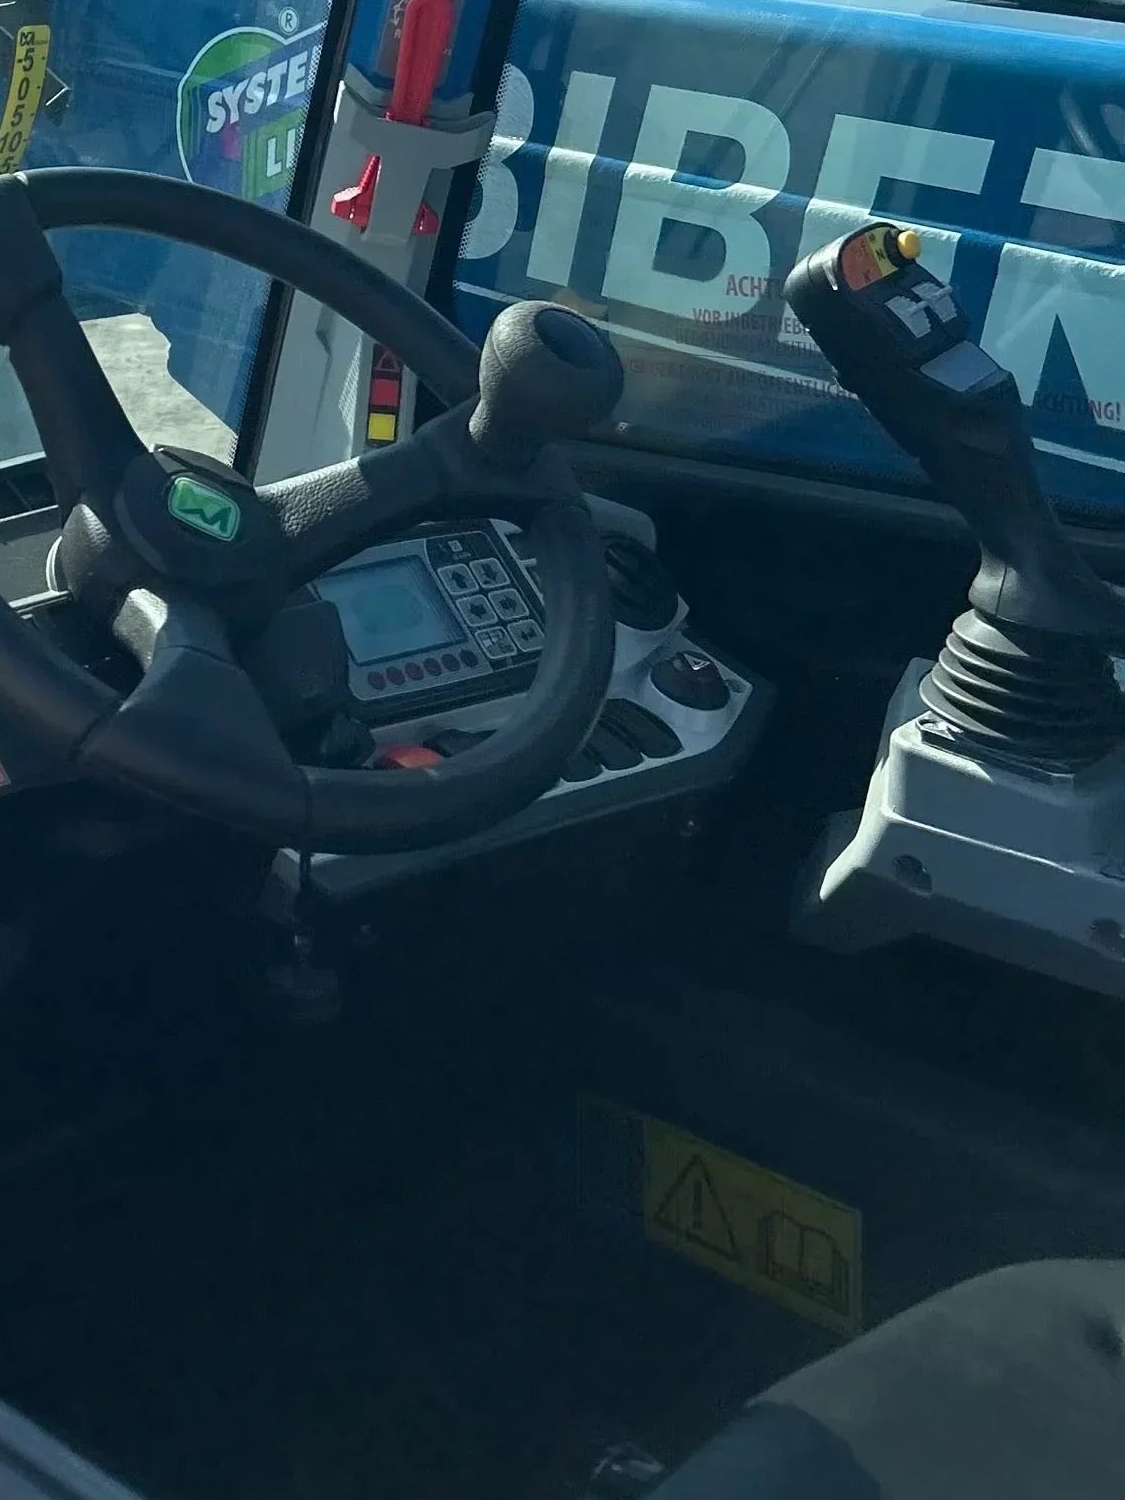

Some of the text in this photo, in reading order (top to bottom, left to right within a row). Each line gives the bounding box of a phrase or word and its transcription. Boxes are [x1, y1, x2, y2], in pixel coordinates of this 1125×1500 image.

[17, 77, 30, 101] 0
[10, 105, 26, 127] 5
[693, 307, 721, 327] VOR
